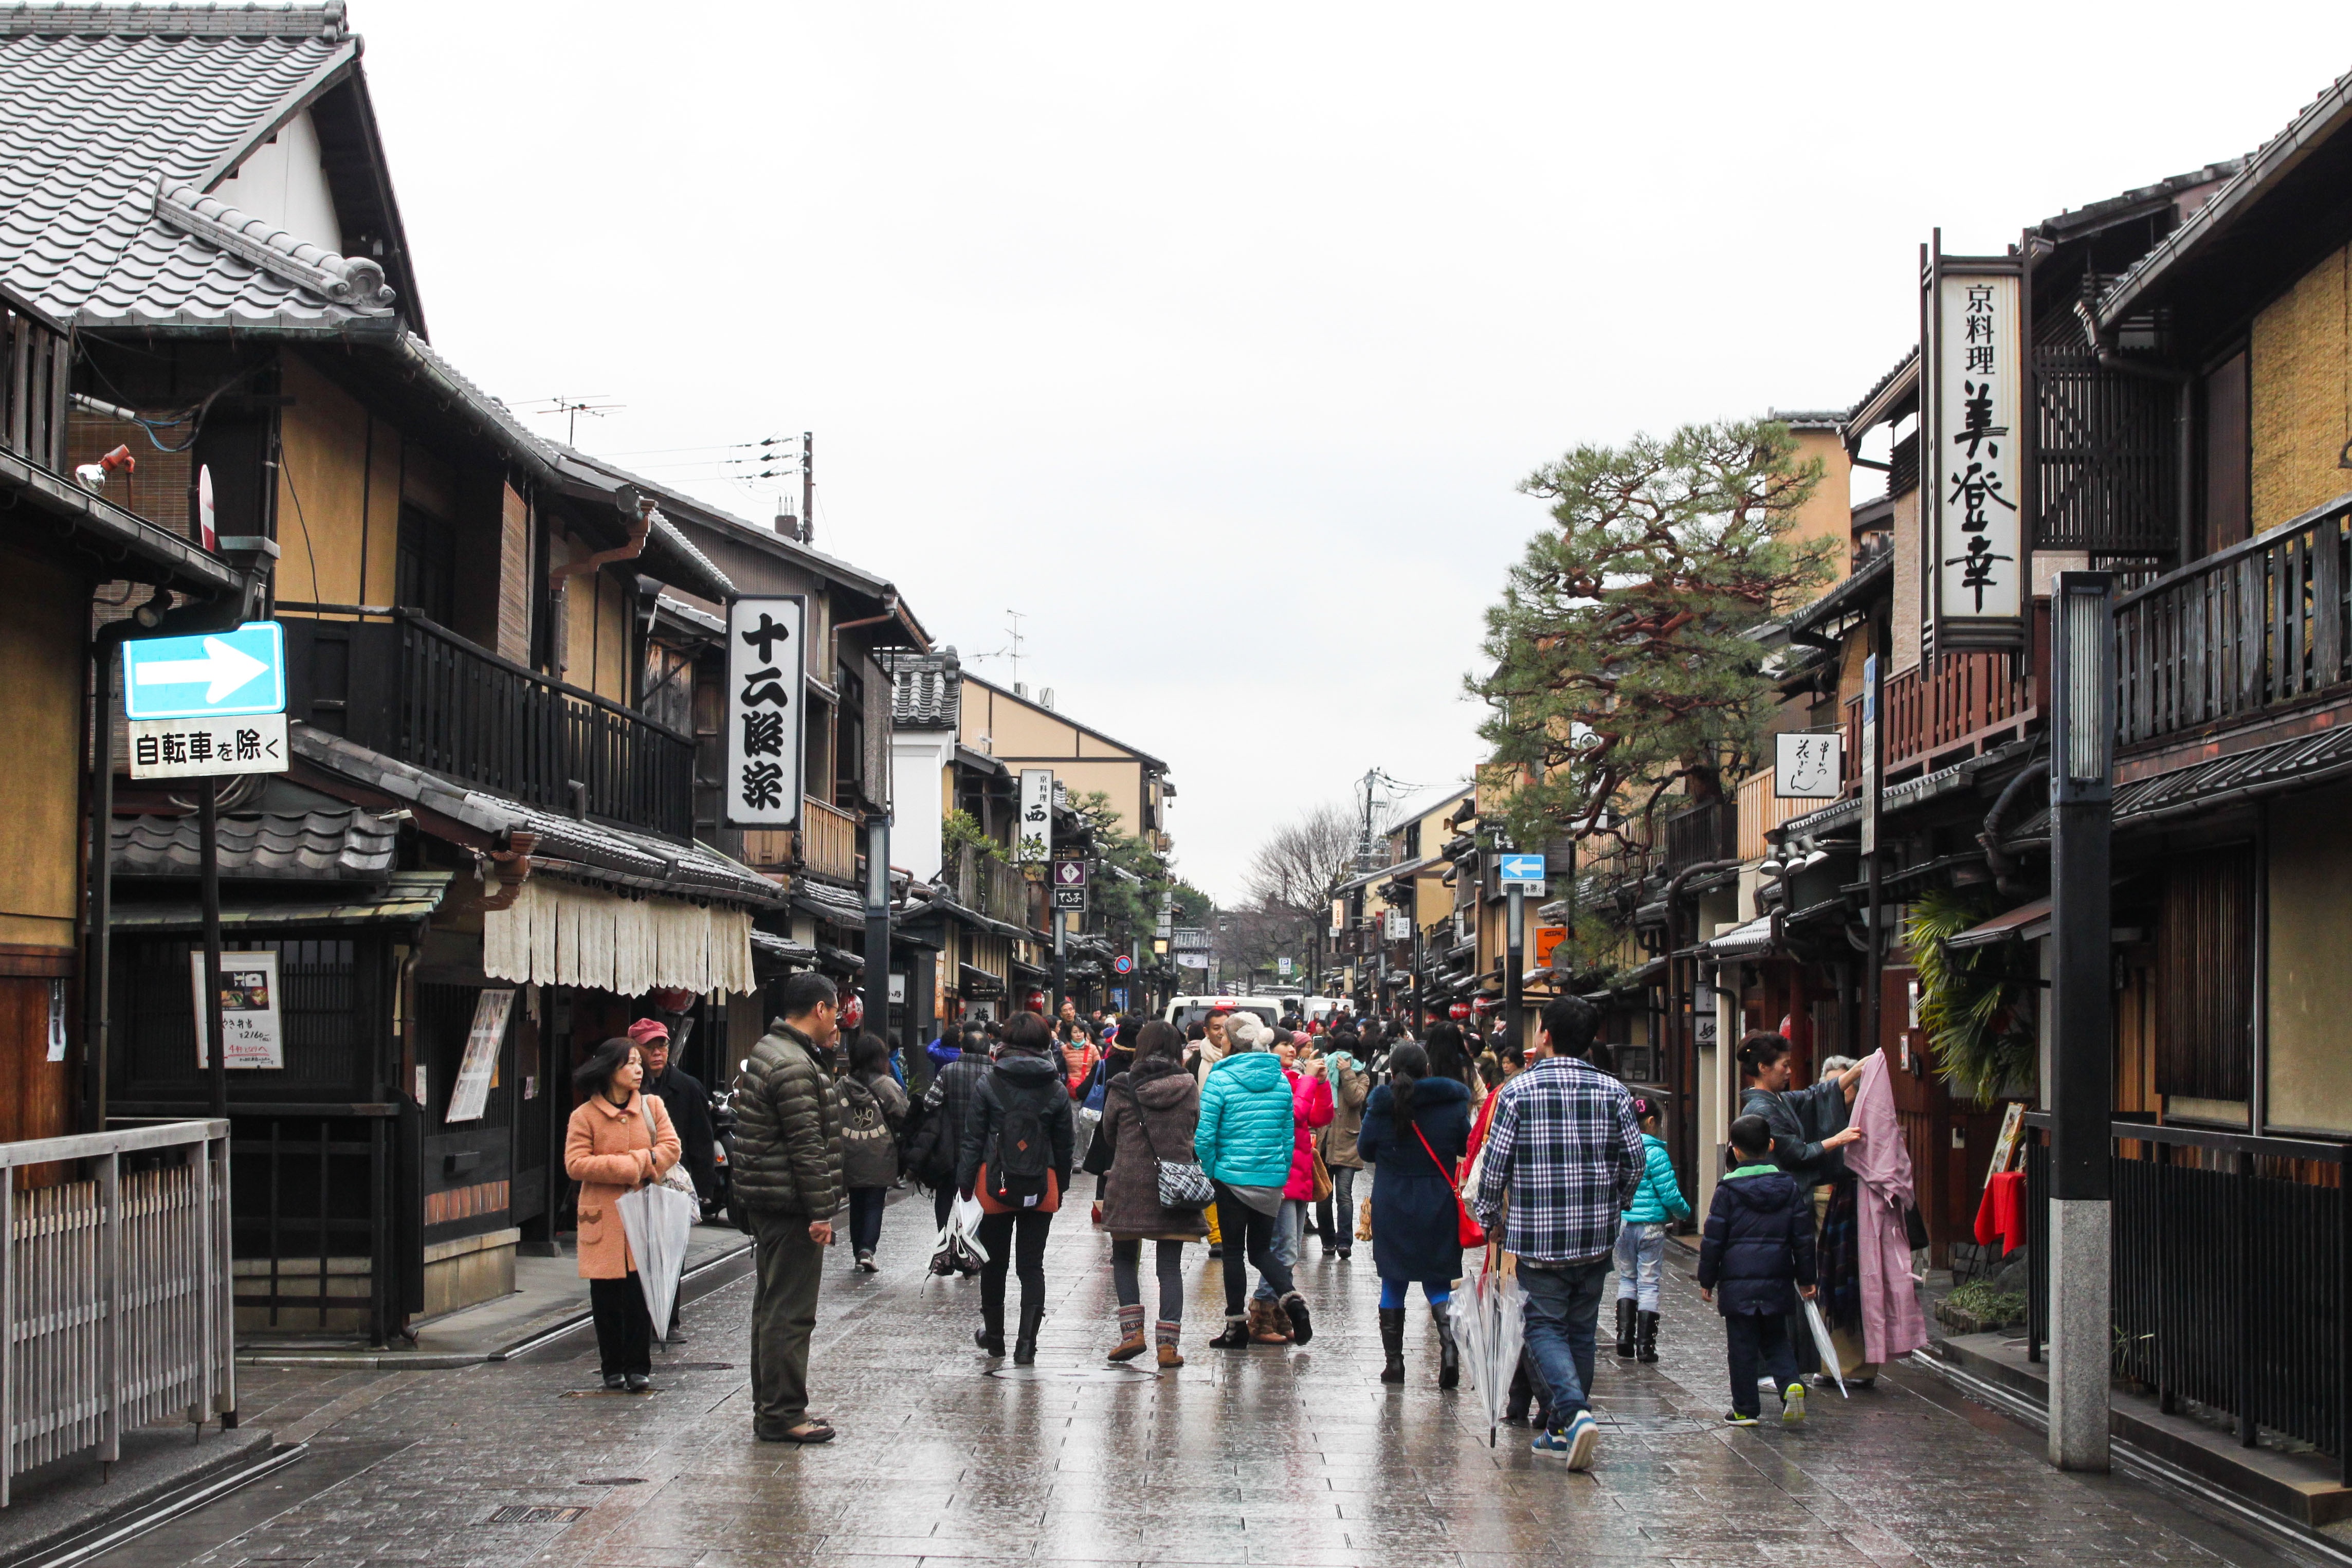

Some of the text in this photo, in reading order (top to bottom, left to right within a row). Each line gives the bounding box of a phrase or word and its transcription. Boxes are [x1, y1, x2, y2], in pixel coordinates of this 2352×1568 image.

[1965, 284, 1996, 375] 京料理
[1945, 379, 2018, 614] 美登幸
[137, 728, 279, 765] 自転車を除く
[741, 612, 789, 810] 十二段家
[1039, 775, 1048, 803] 京料理
